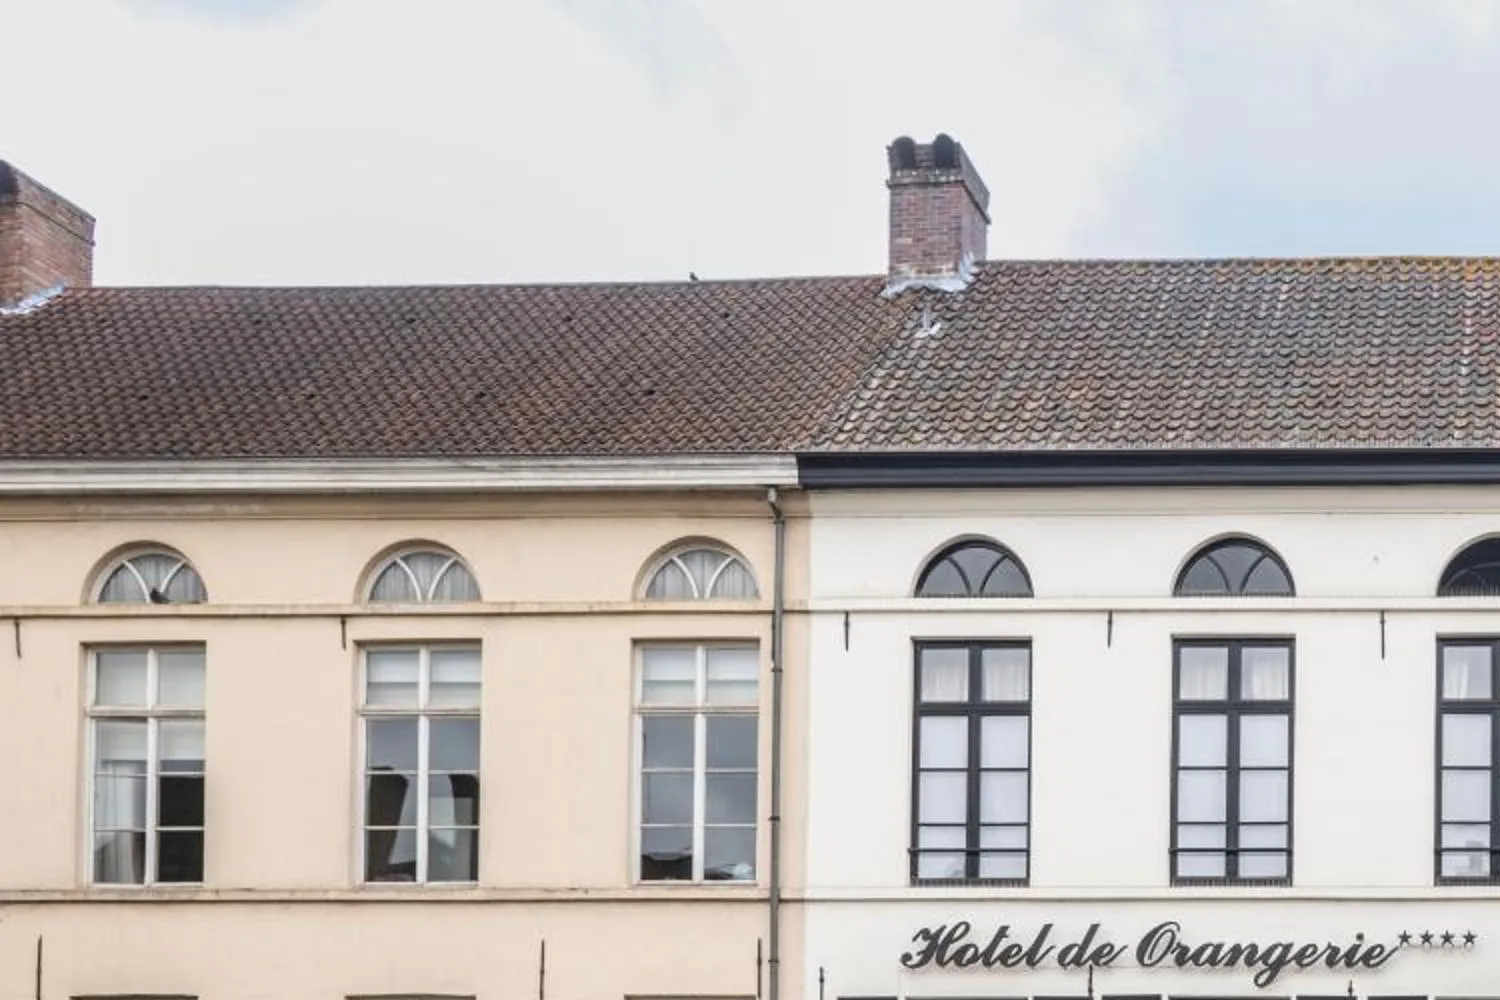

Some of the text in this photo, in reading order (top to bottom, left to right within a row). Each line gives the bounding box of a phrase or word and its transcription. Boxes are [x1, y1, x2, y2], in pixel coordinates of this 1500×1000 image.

[900, 921, 1400, 988] Hotel de Orangerie
